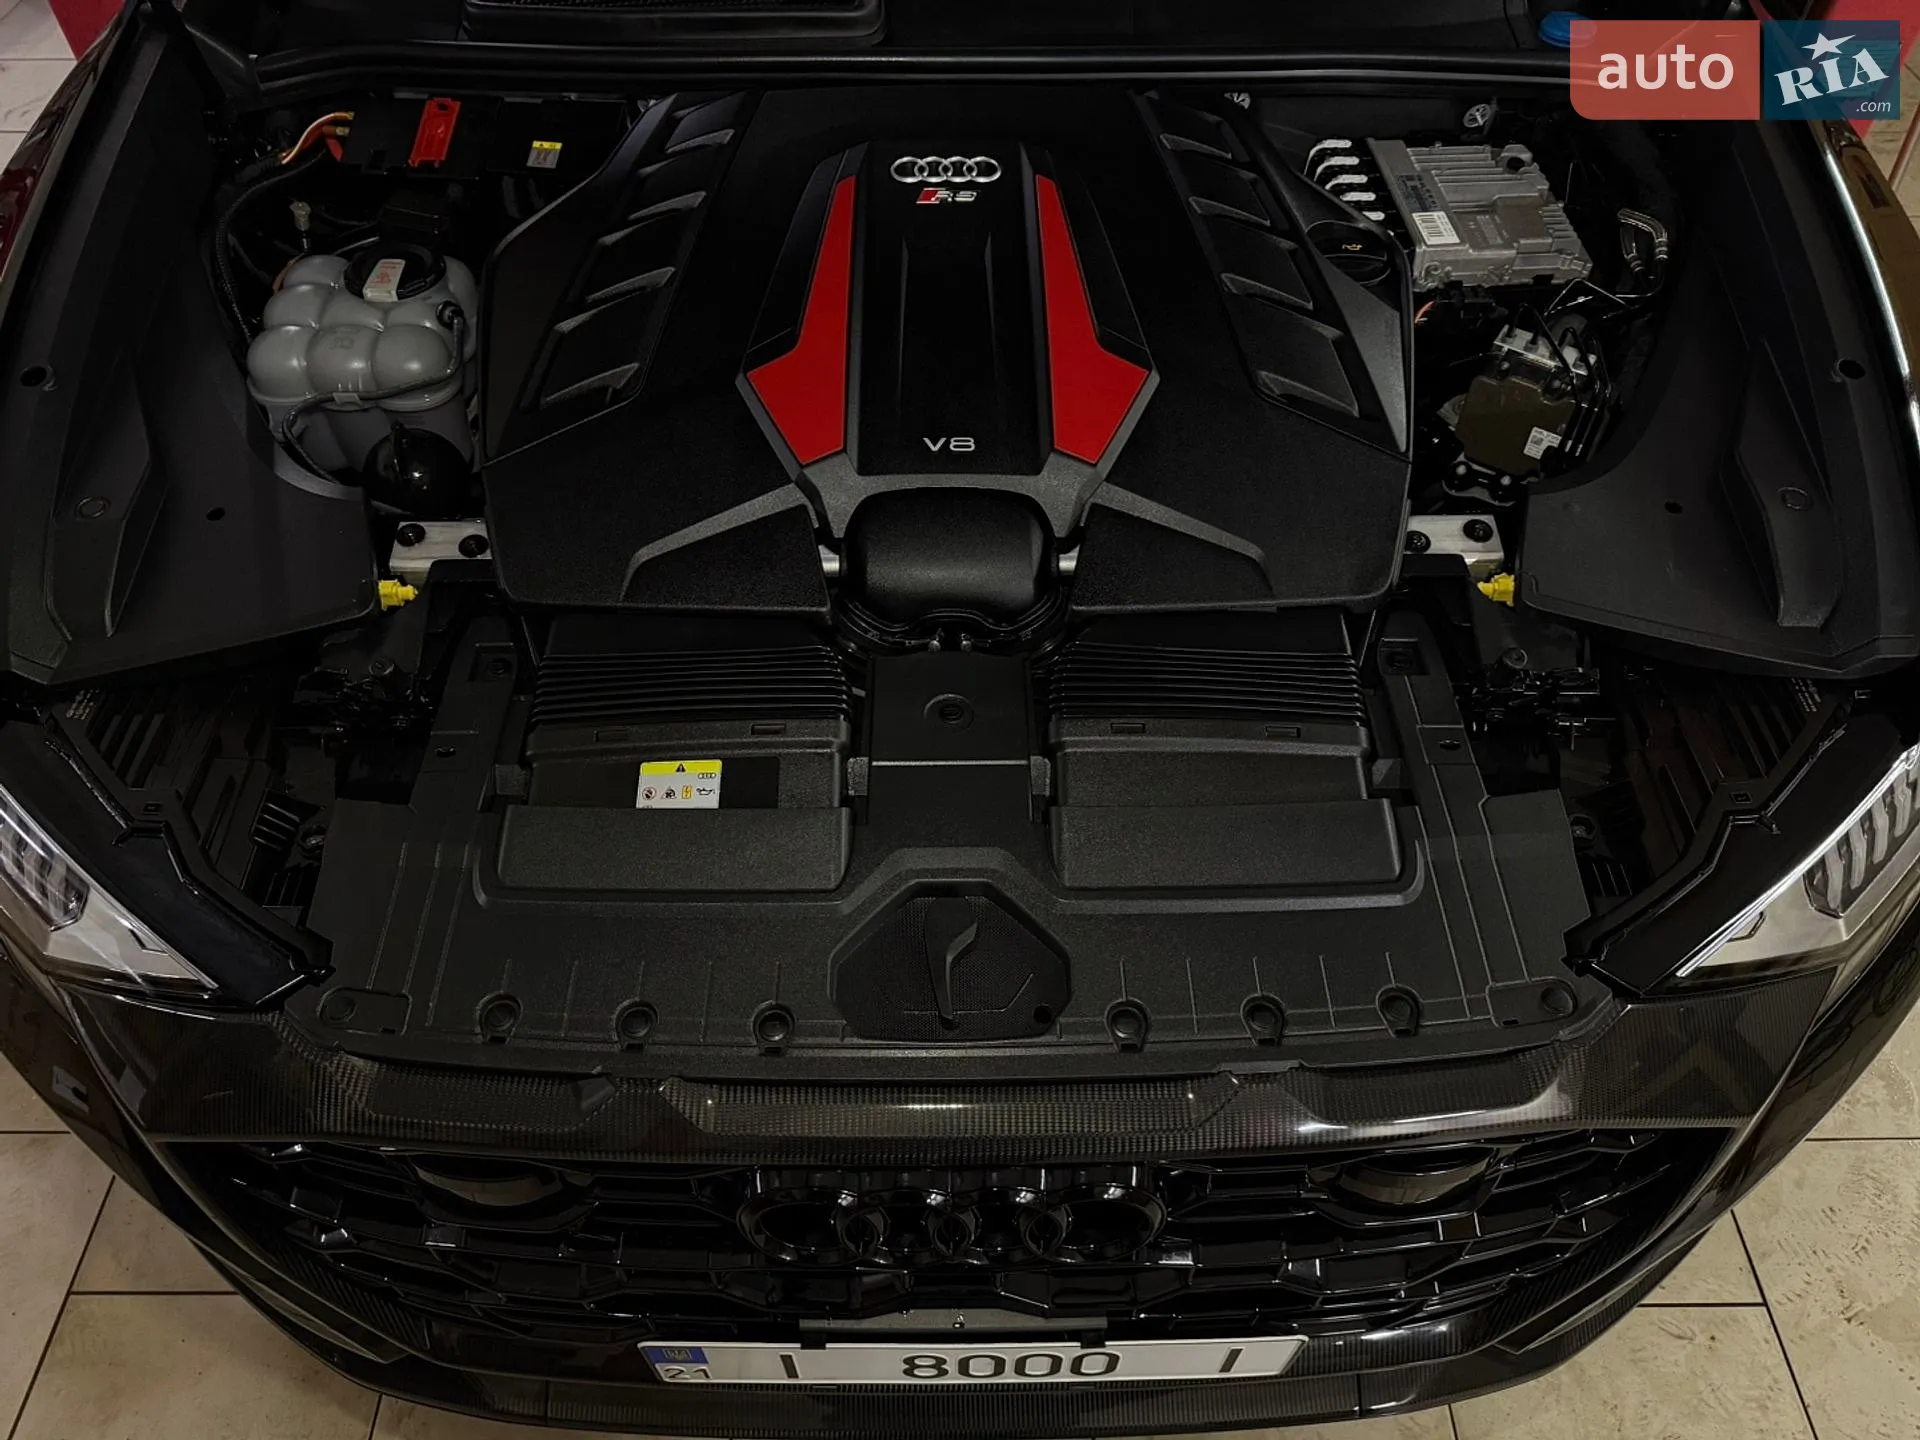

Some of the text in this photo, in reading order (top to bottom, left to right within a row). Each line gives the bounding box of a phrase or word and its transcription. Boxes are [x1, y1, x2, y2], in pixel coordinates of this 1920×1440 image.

[922, 436, 976, 452] V8
[663, 1366, 712, 1380] 21
[902, 1351, 1121, 1379] 8000
